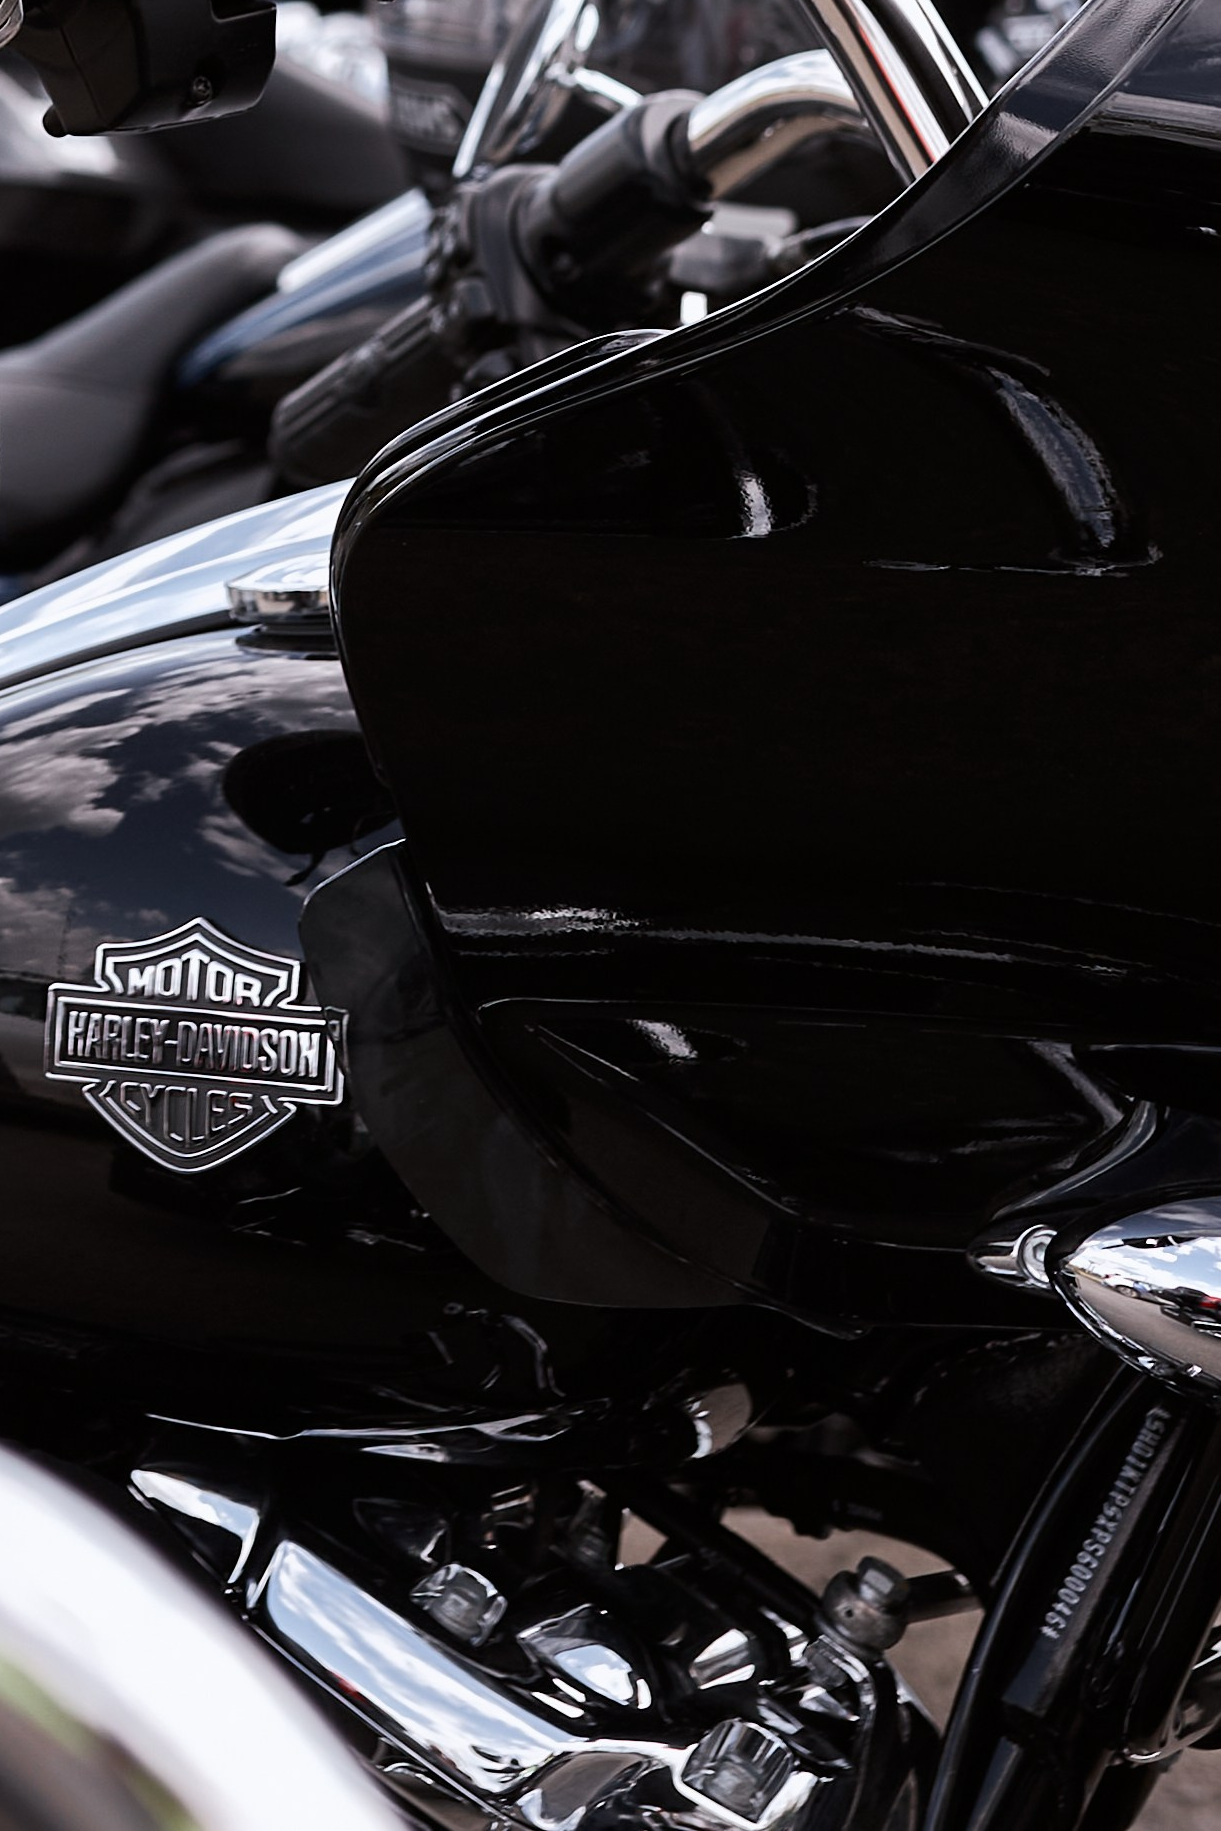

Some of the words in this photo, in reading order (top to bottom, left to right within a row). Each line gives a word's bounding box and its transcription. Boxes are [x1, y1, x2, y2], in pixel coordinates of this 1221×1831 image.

[127, 948, 261, 1008] MOTOR
[68, 1011, 322, 1078] HARLEY-DAVIDSON
[121, 1081, 254, 1147] CYCLES
